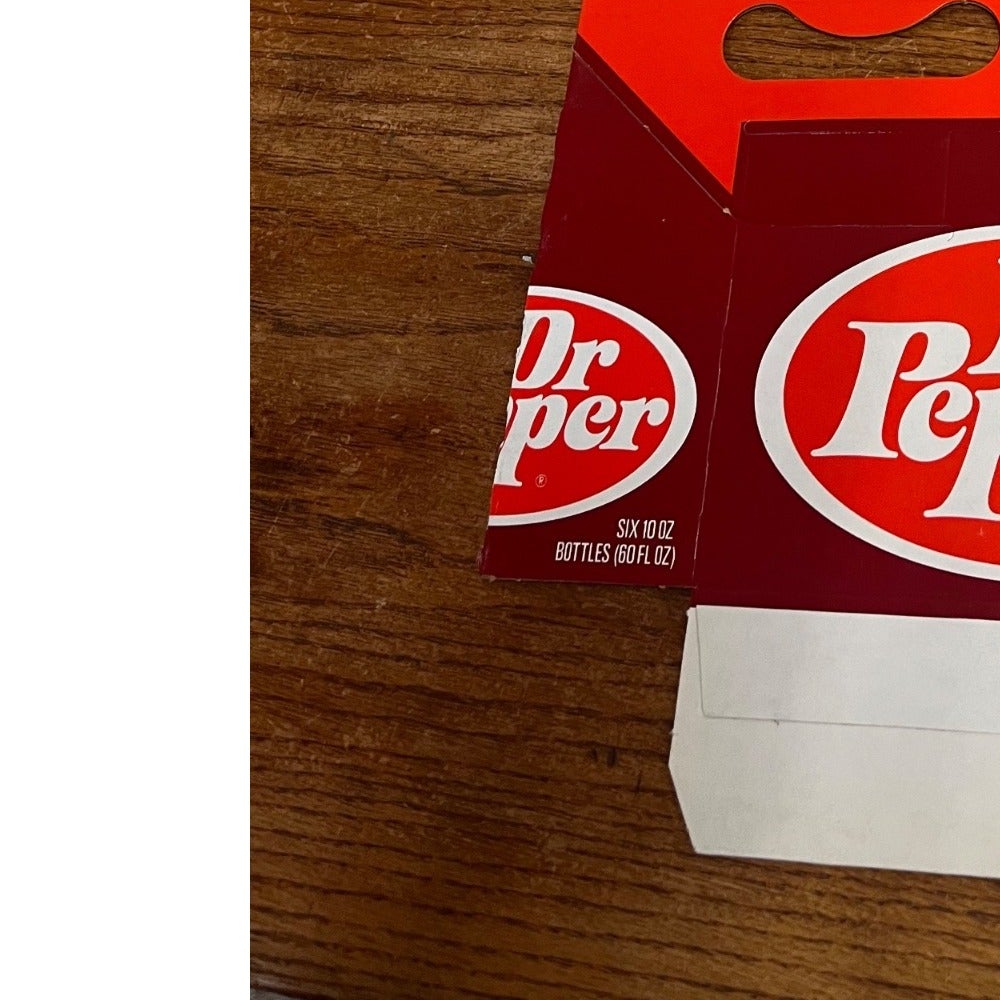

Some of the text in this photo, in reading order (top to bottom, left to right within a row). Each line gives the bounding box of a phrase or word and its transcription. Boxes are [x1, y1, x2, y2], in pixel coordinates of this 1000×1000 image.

[493, 394, 670, 487] per
[616, 518, 675, 540] SIX 10 OZ
[555, 541, 611, 563] BOTTLES
[654, 545, 675, 570] OZ)
